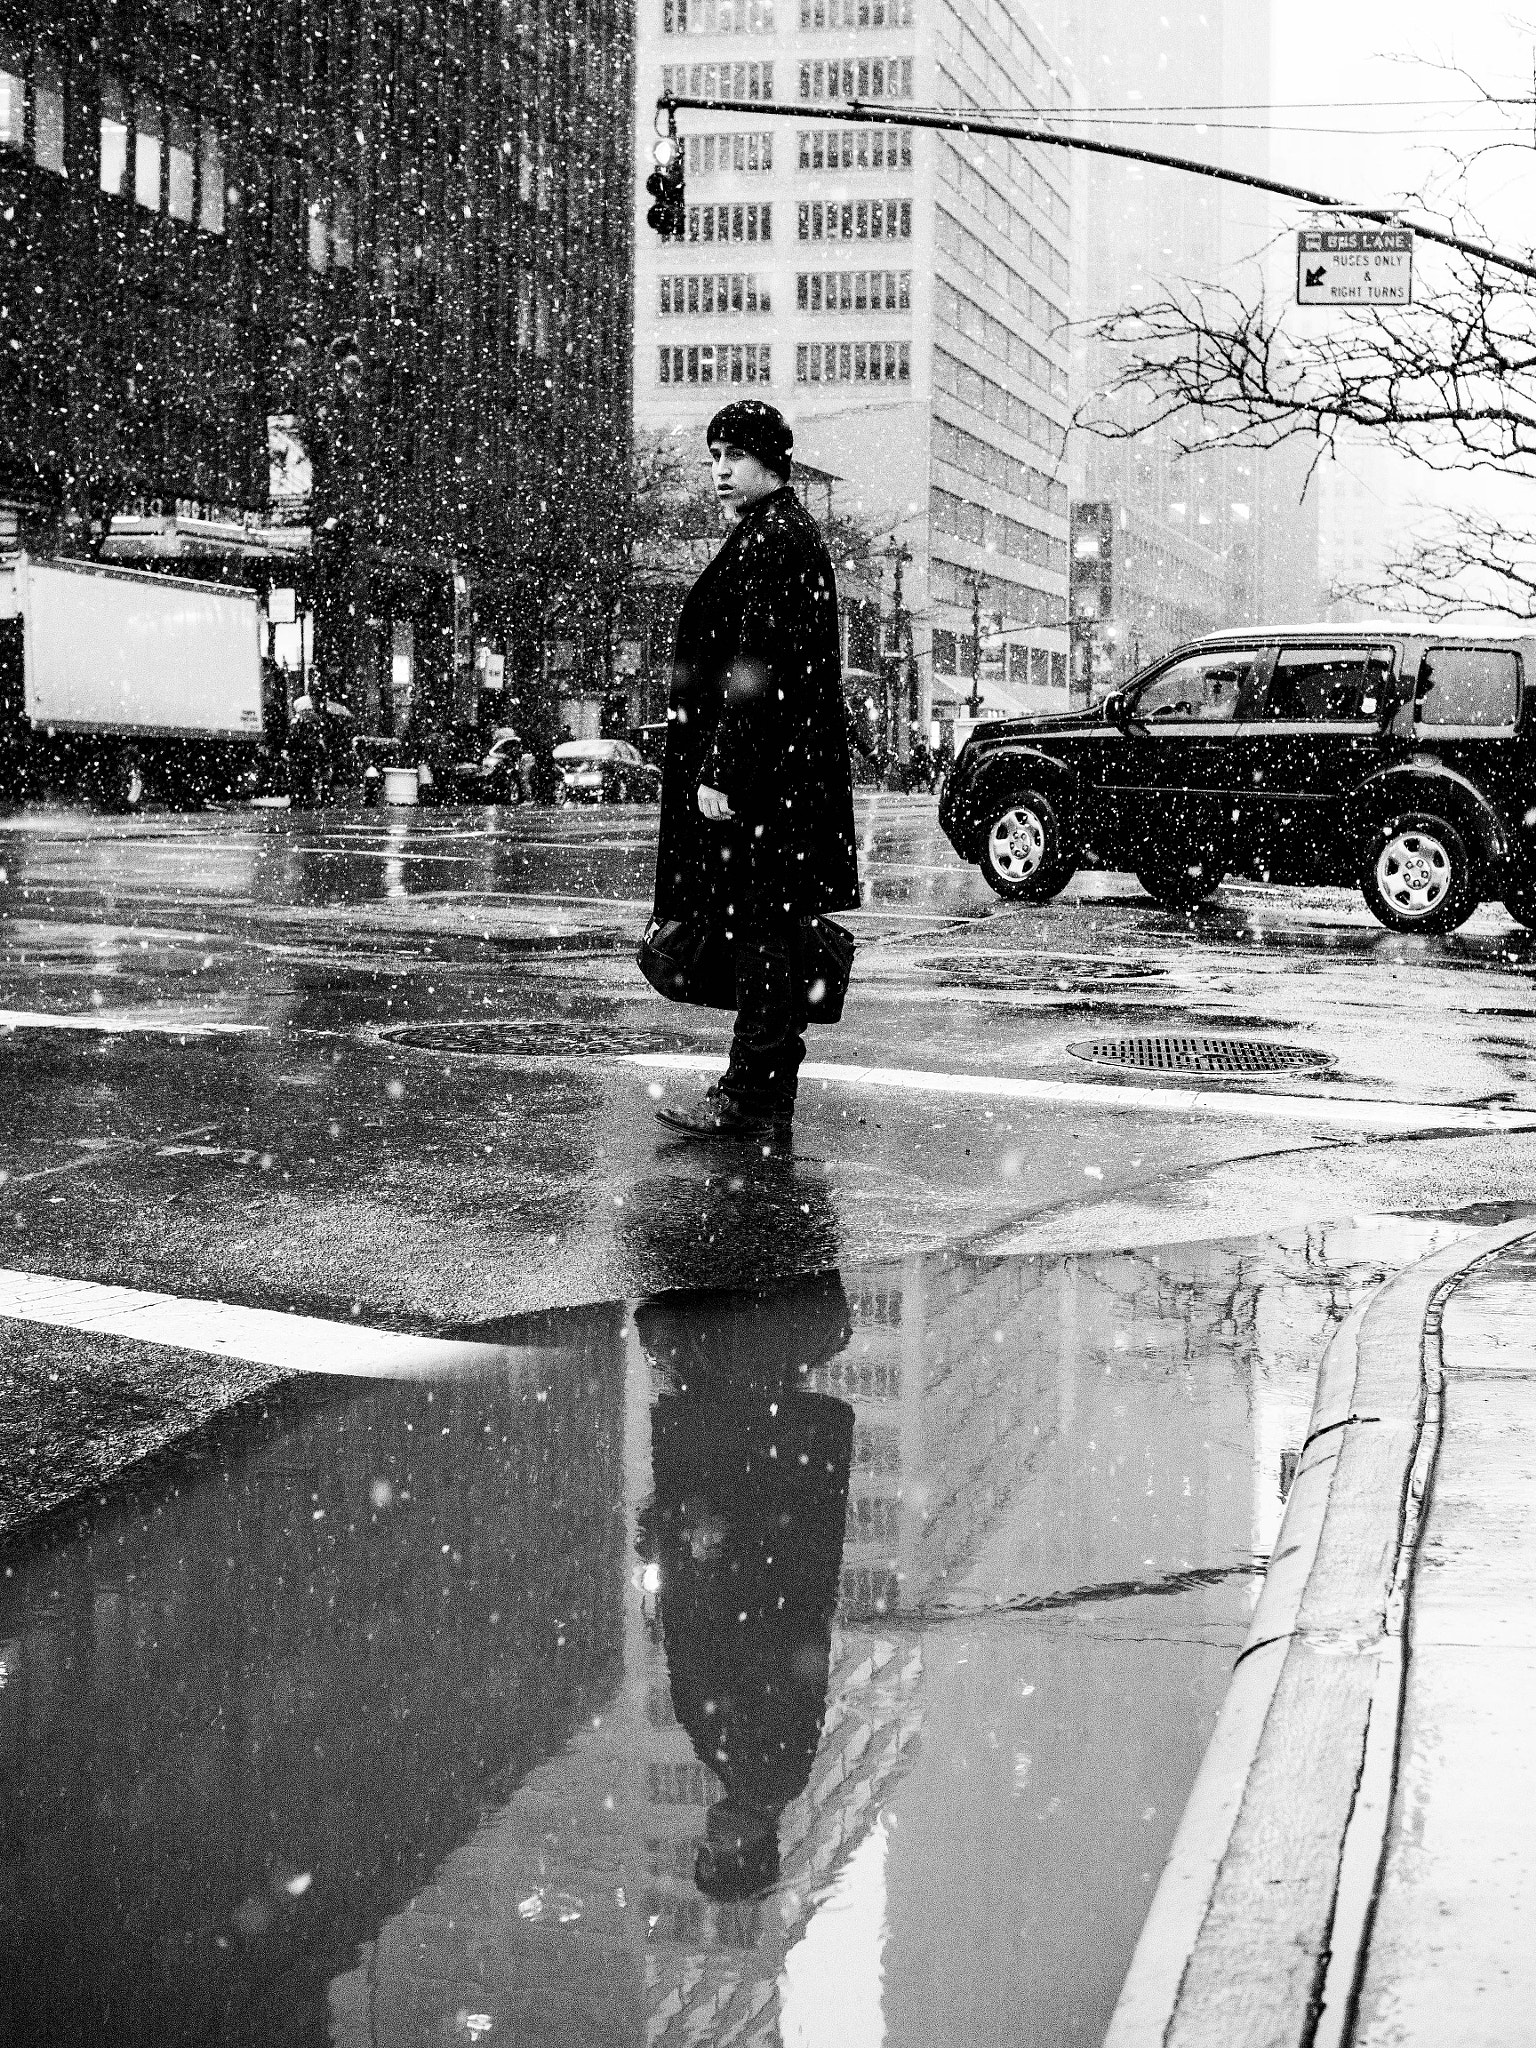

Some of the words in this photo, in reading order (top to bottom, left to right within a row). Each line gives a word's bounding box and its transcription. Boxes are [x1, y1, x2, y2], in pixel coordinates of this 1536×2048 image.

[1363, 235, 1406, 249] LANE
[1333, 255, 1369, 266] BUSES
[1374, 255, 1402, 266] ONLY
[1364, 271, 1371, 281] &
[1331, 287, 1362, 298] RIGHT
[1368, 287, 1404, 298] TURNS
